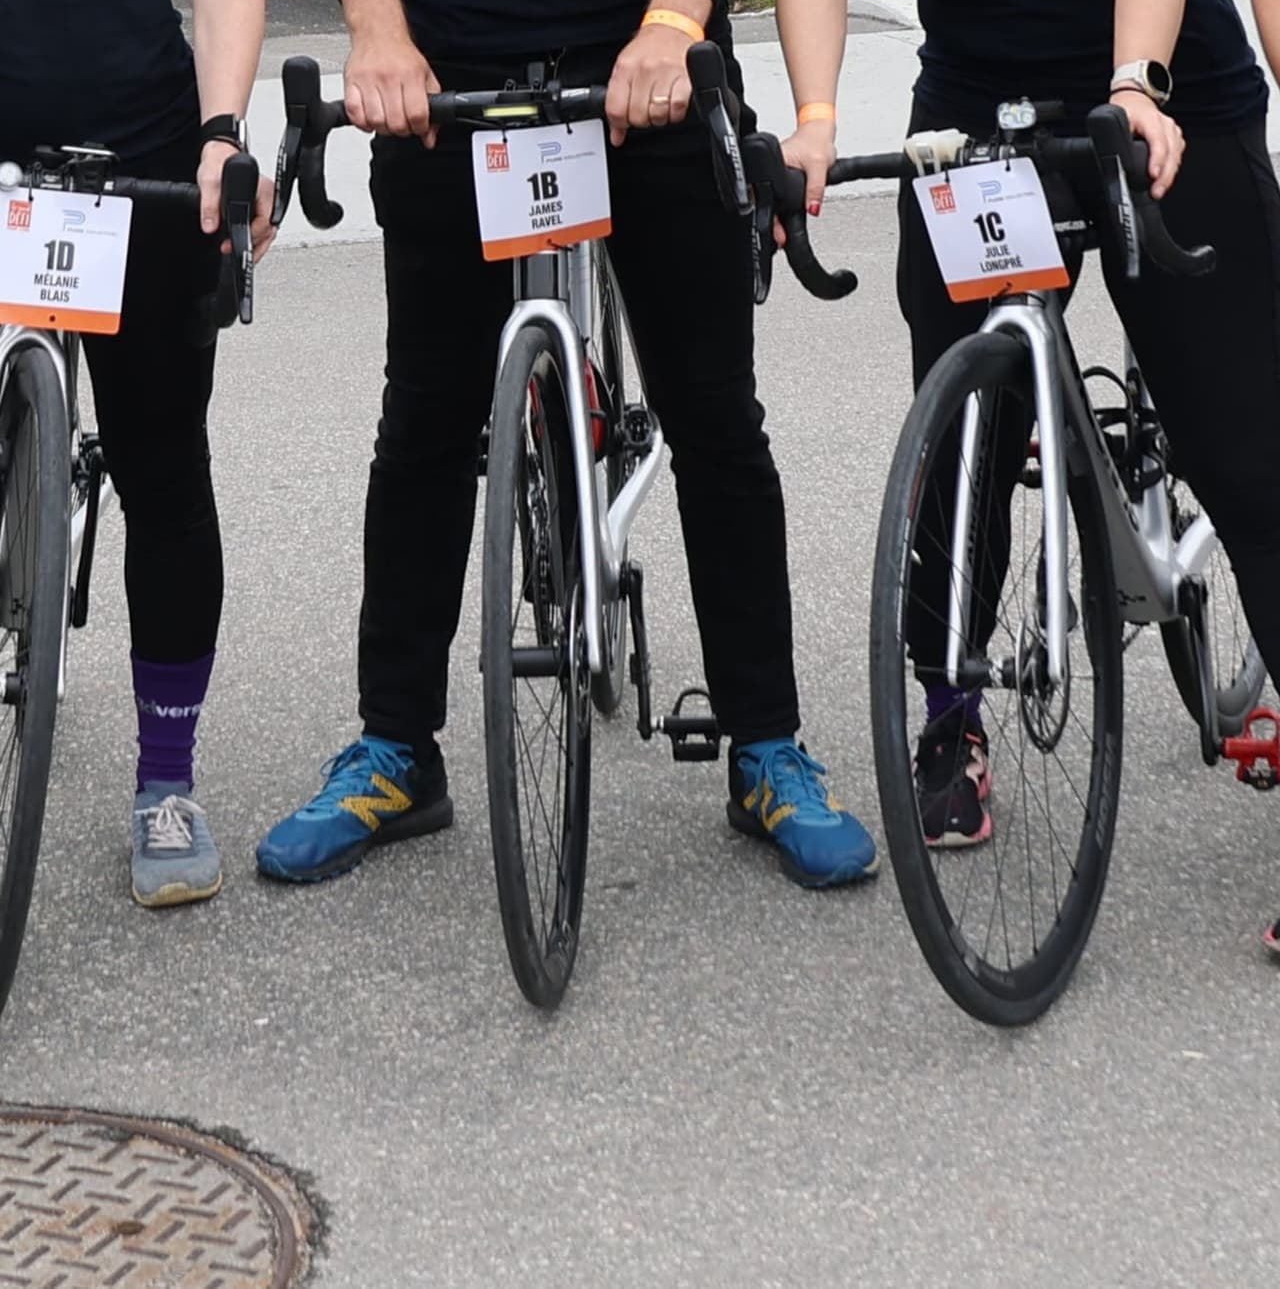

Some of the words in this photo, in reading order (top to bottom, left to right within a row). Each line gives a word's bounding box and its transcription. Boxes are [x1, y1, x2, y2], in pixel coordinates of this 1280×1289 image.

[526, 170, 560, 202] 1B
[528, 199, 564, 218] JAMES
[531, 214, 564, 231] RAVEL
[973, 211, 1007, 244] 1C
[44, 239, 75, 272] 1D
[983, 244, 1012, 258] JULIE
[979, 256, 1025, 274] LONGPRÉ
[33, 272, 81, 289] MÉLANIE
[39, 288, 71, 303] BLAIS
